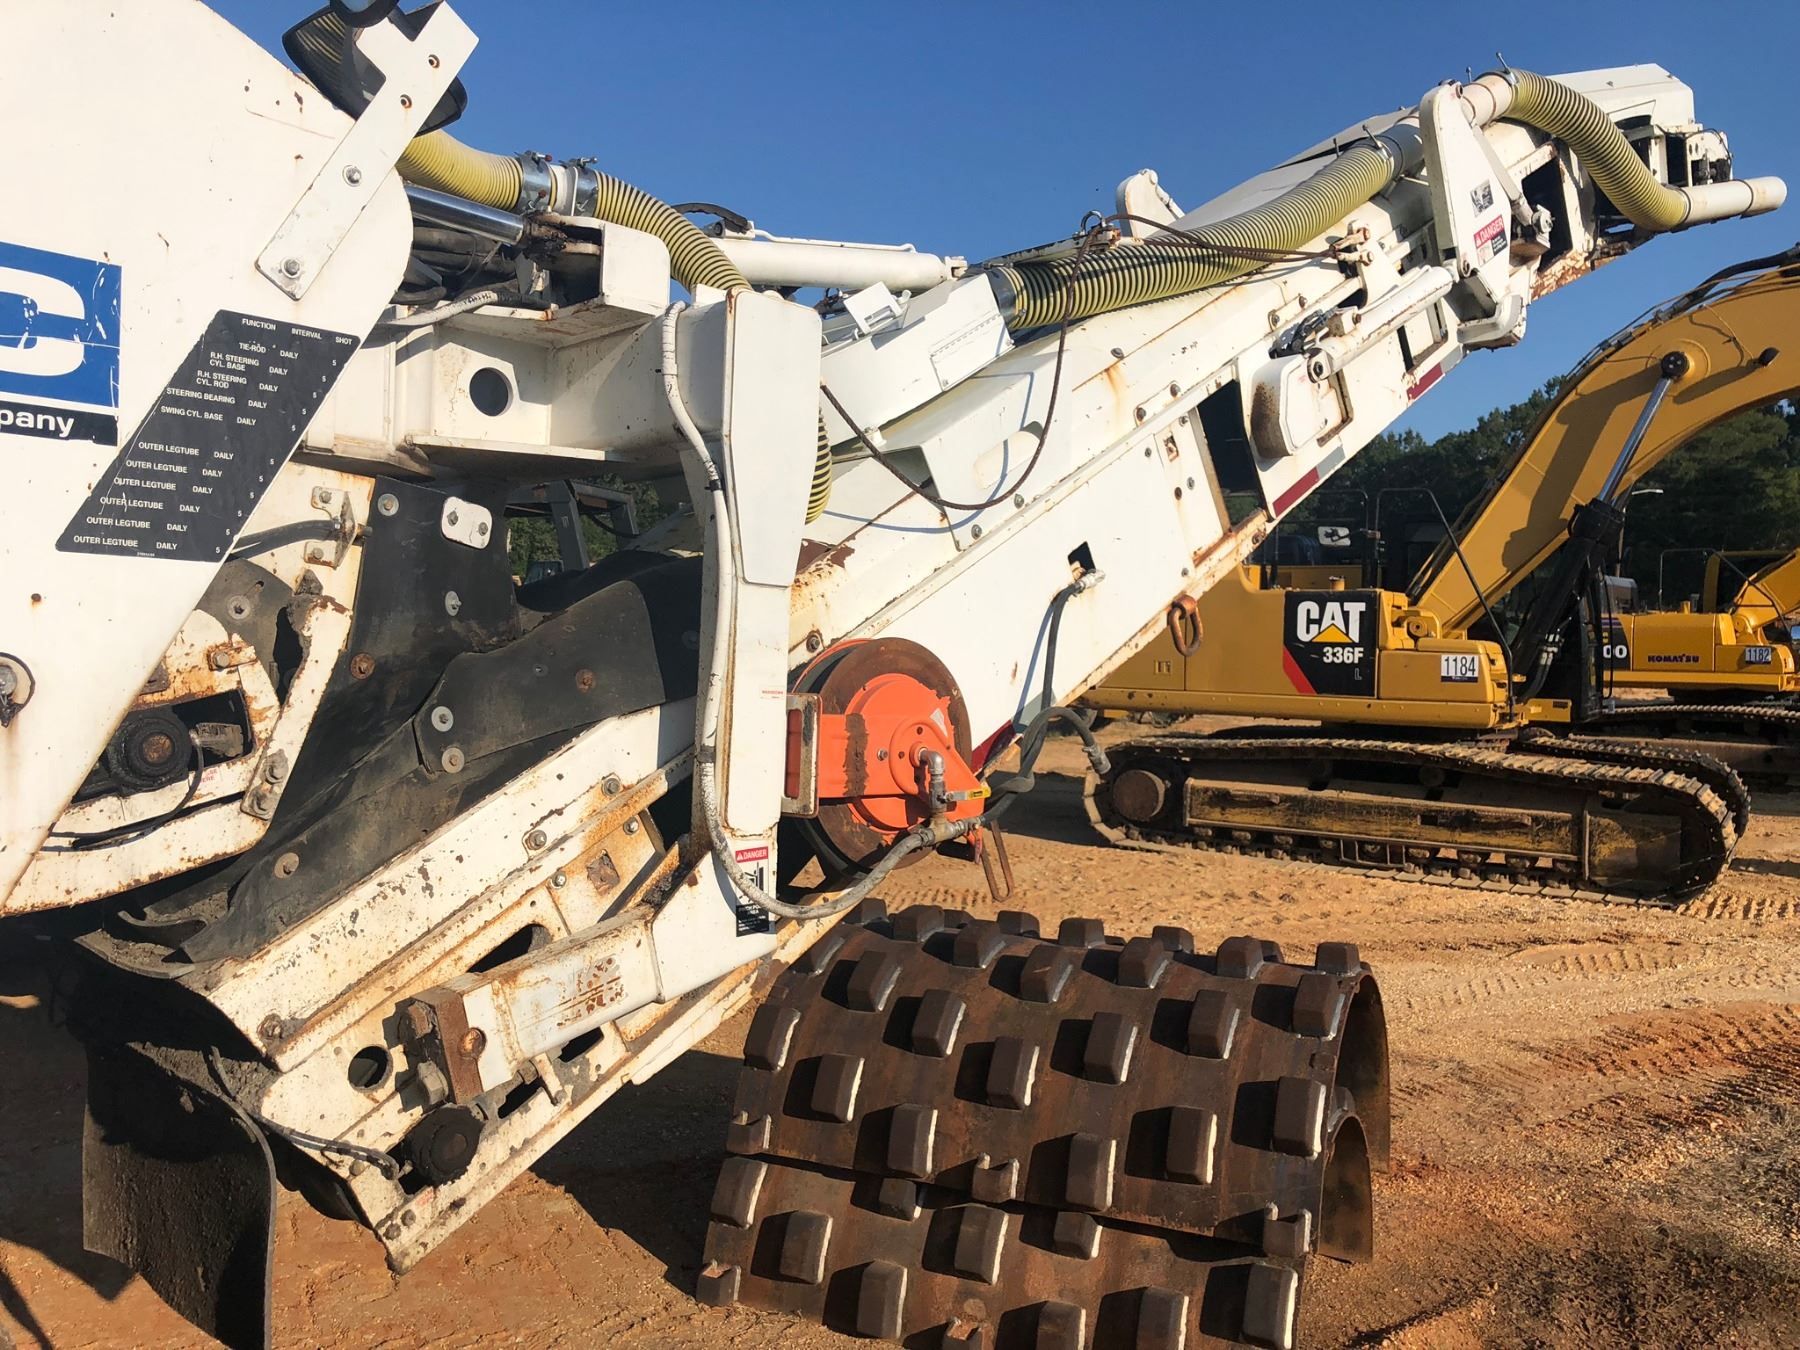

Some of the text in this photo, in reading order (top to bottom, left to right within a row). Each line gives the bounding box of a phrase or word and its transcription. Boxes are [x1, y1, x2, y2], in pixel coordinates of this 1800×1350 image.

[242, 318, 353, 345] FUNCTION INTERVAL SHOT
[239, 342, 266, 353] TIE-ROD
[280, 350, 299, 359] DAILY
[210, 352, 260, 366] R.H. STEERING
[210, 359, 246, 371] CYL. BASE
[197, 370, 247, 385] R.H. STEERING
[269, 366, 288, 376] DAILY
[196, 378, 229, 389] CYL. ROD
[259, 383, 278, 392] DAILY
[166, 388, 202, 399] STEERING
[204, 392, 236, 404] BEARING
[248, 400, 267, 409] DAILY
[161, 406, 185, 416] SWING
[186, 409, 202, 418] CYL.
[204, 412, 223, 421] BASE
[236, 417, 256, 425] DAILY
[138, 442, 164, 451] OUTER
[165, 444, 200, 455] LEGTUBE
[214, 451, 234, 460] DAILY
[126, 460, 152, 469] OUTER
[153, 463, 188, 473] LEGTUBE
[202, 468, 222, 478] DAILY
[114, 477, 140, 487] OUTER
[141, 480, 177, 490] LEGTUBE
[192, 485, 213, 494] DAILY
[100, 496, 127, 506] OUTER
[128, 499, 164, 510] LEGTUBE
[180, 504, 200, 513] DAILY
[86, 516, 114, 525] OUTER
[115, 519, 151, 529] LEGTUBE
[166, 523, 188, 532] DAILY
[73, 535, 101, 545] OUTER
[102, 538, 138, 548] LEGTUBE
[156, 542, 178, 550] DAILY
[1296, 600, 1366, 643] CAT
[1322, 646, 1364, 664] 336F
[1647, 653, 1700, 663] KOMATSU
[1748, 648, 1770, 661] 1182
[1354, 668, 1362, 680] L
[1444, 656, 1476, 676] 1184
[743, 849, 768, 860] DANGER
